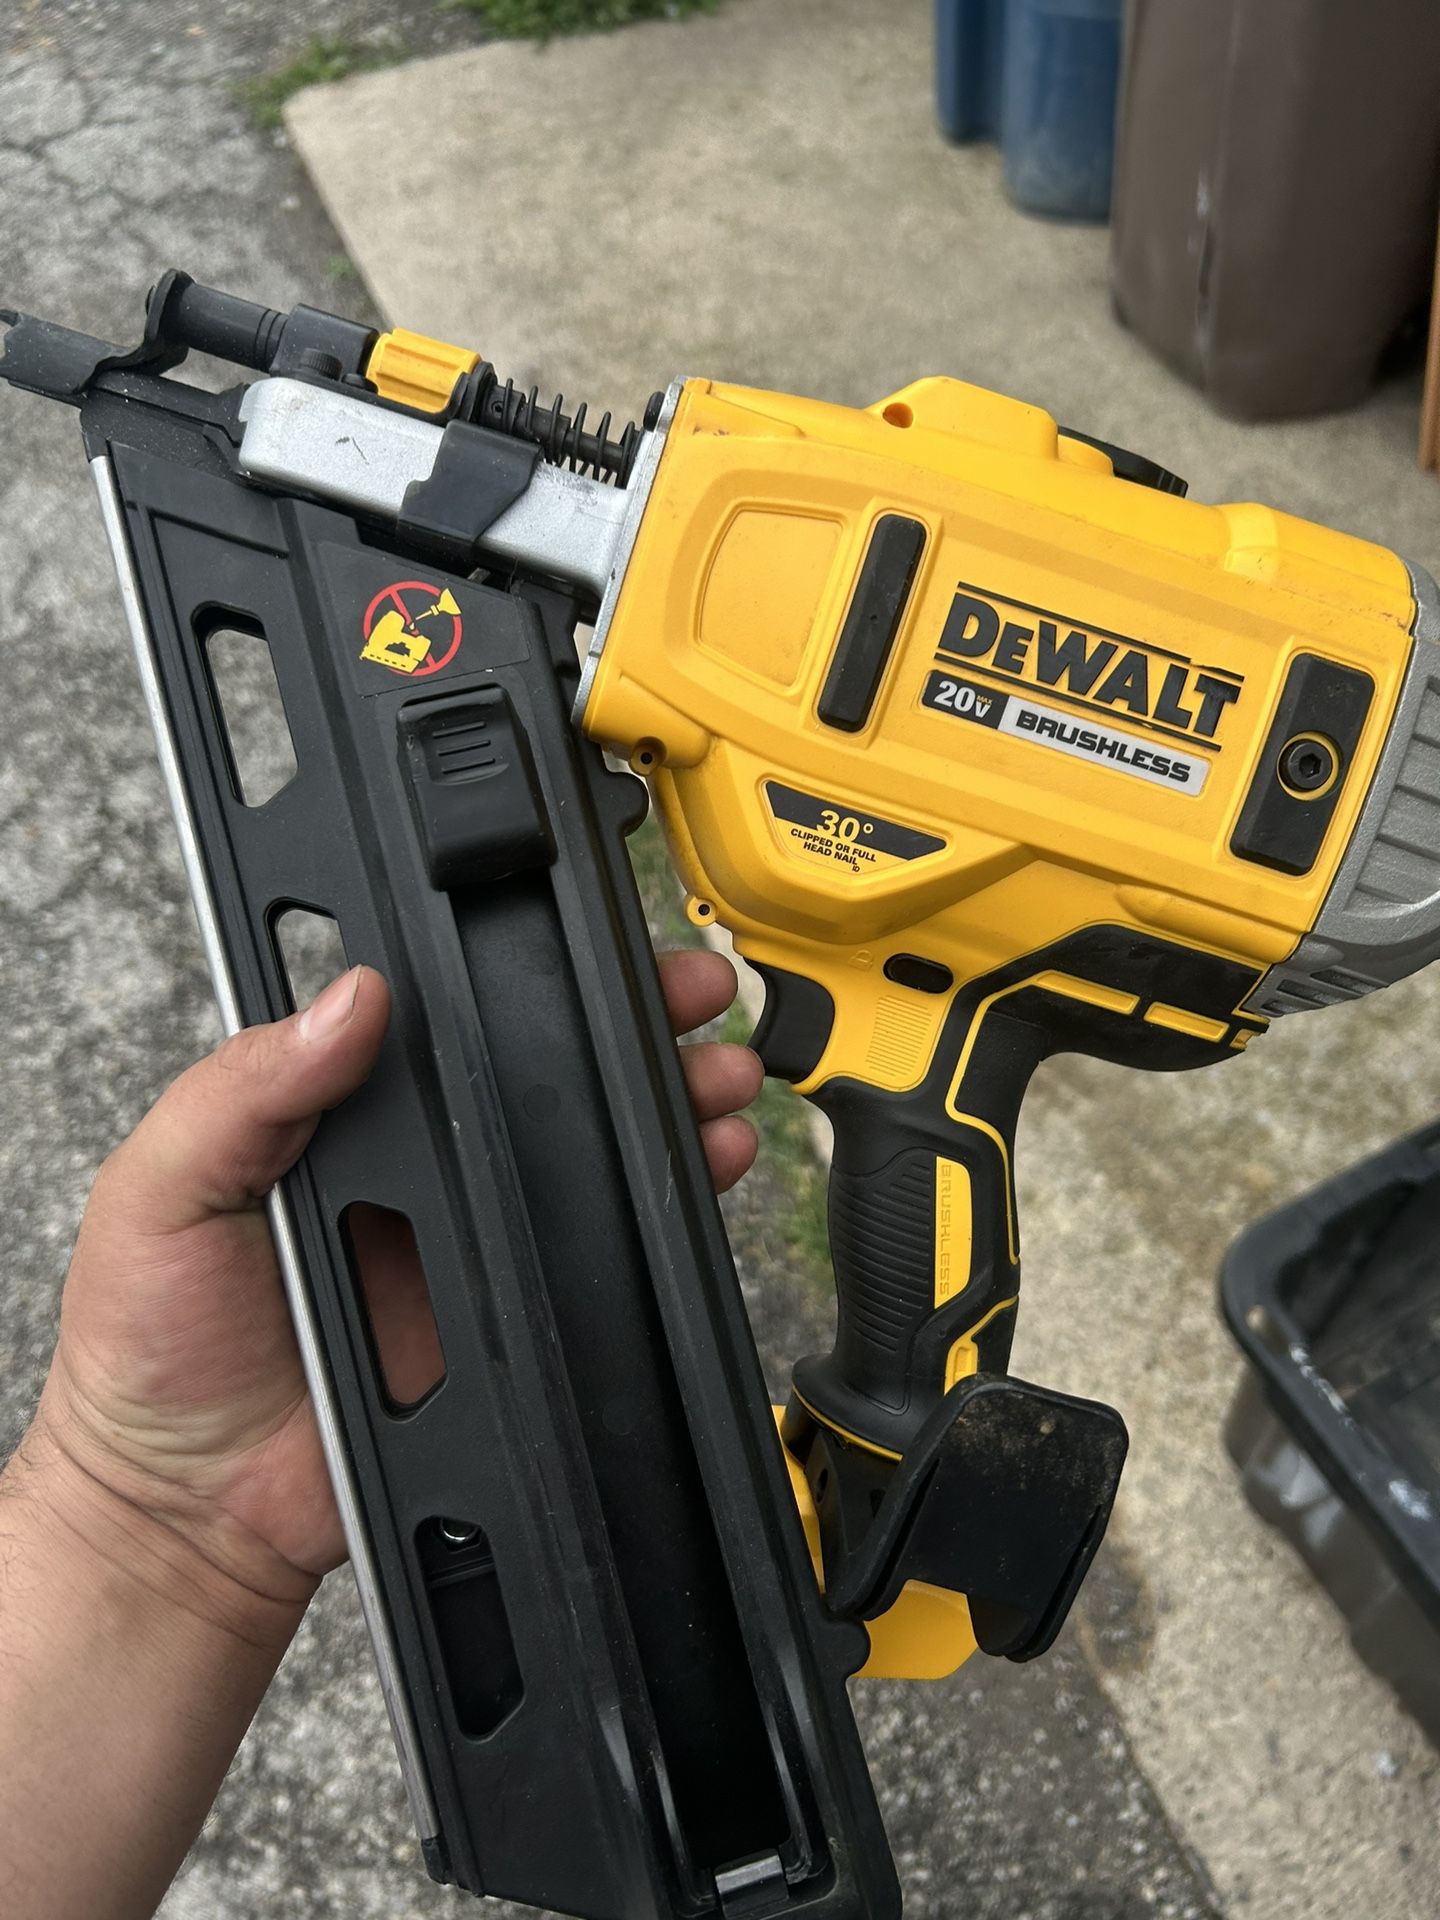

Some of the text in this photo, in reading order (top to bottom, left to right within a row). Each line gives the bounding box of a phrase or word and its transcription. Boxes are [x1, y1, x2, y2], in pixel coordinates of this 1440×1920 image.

[1016, 709, 1191, 784] BRUSHLESS
[816, 809, 874, 844] 30°
[790, 828, 877, 862] CLIPPED OR FULL
[803, 841, 858, 866] HEAD NAIL
[940, 1163, 952, 1296] BRUSHLESS
